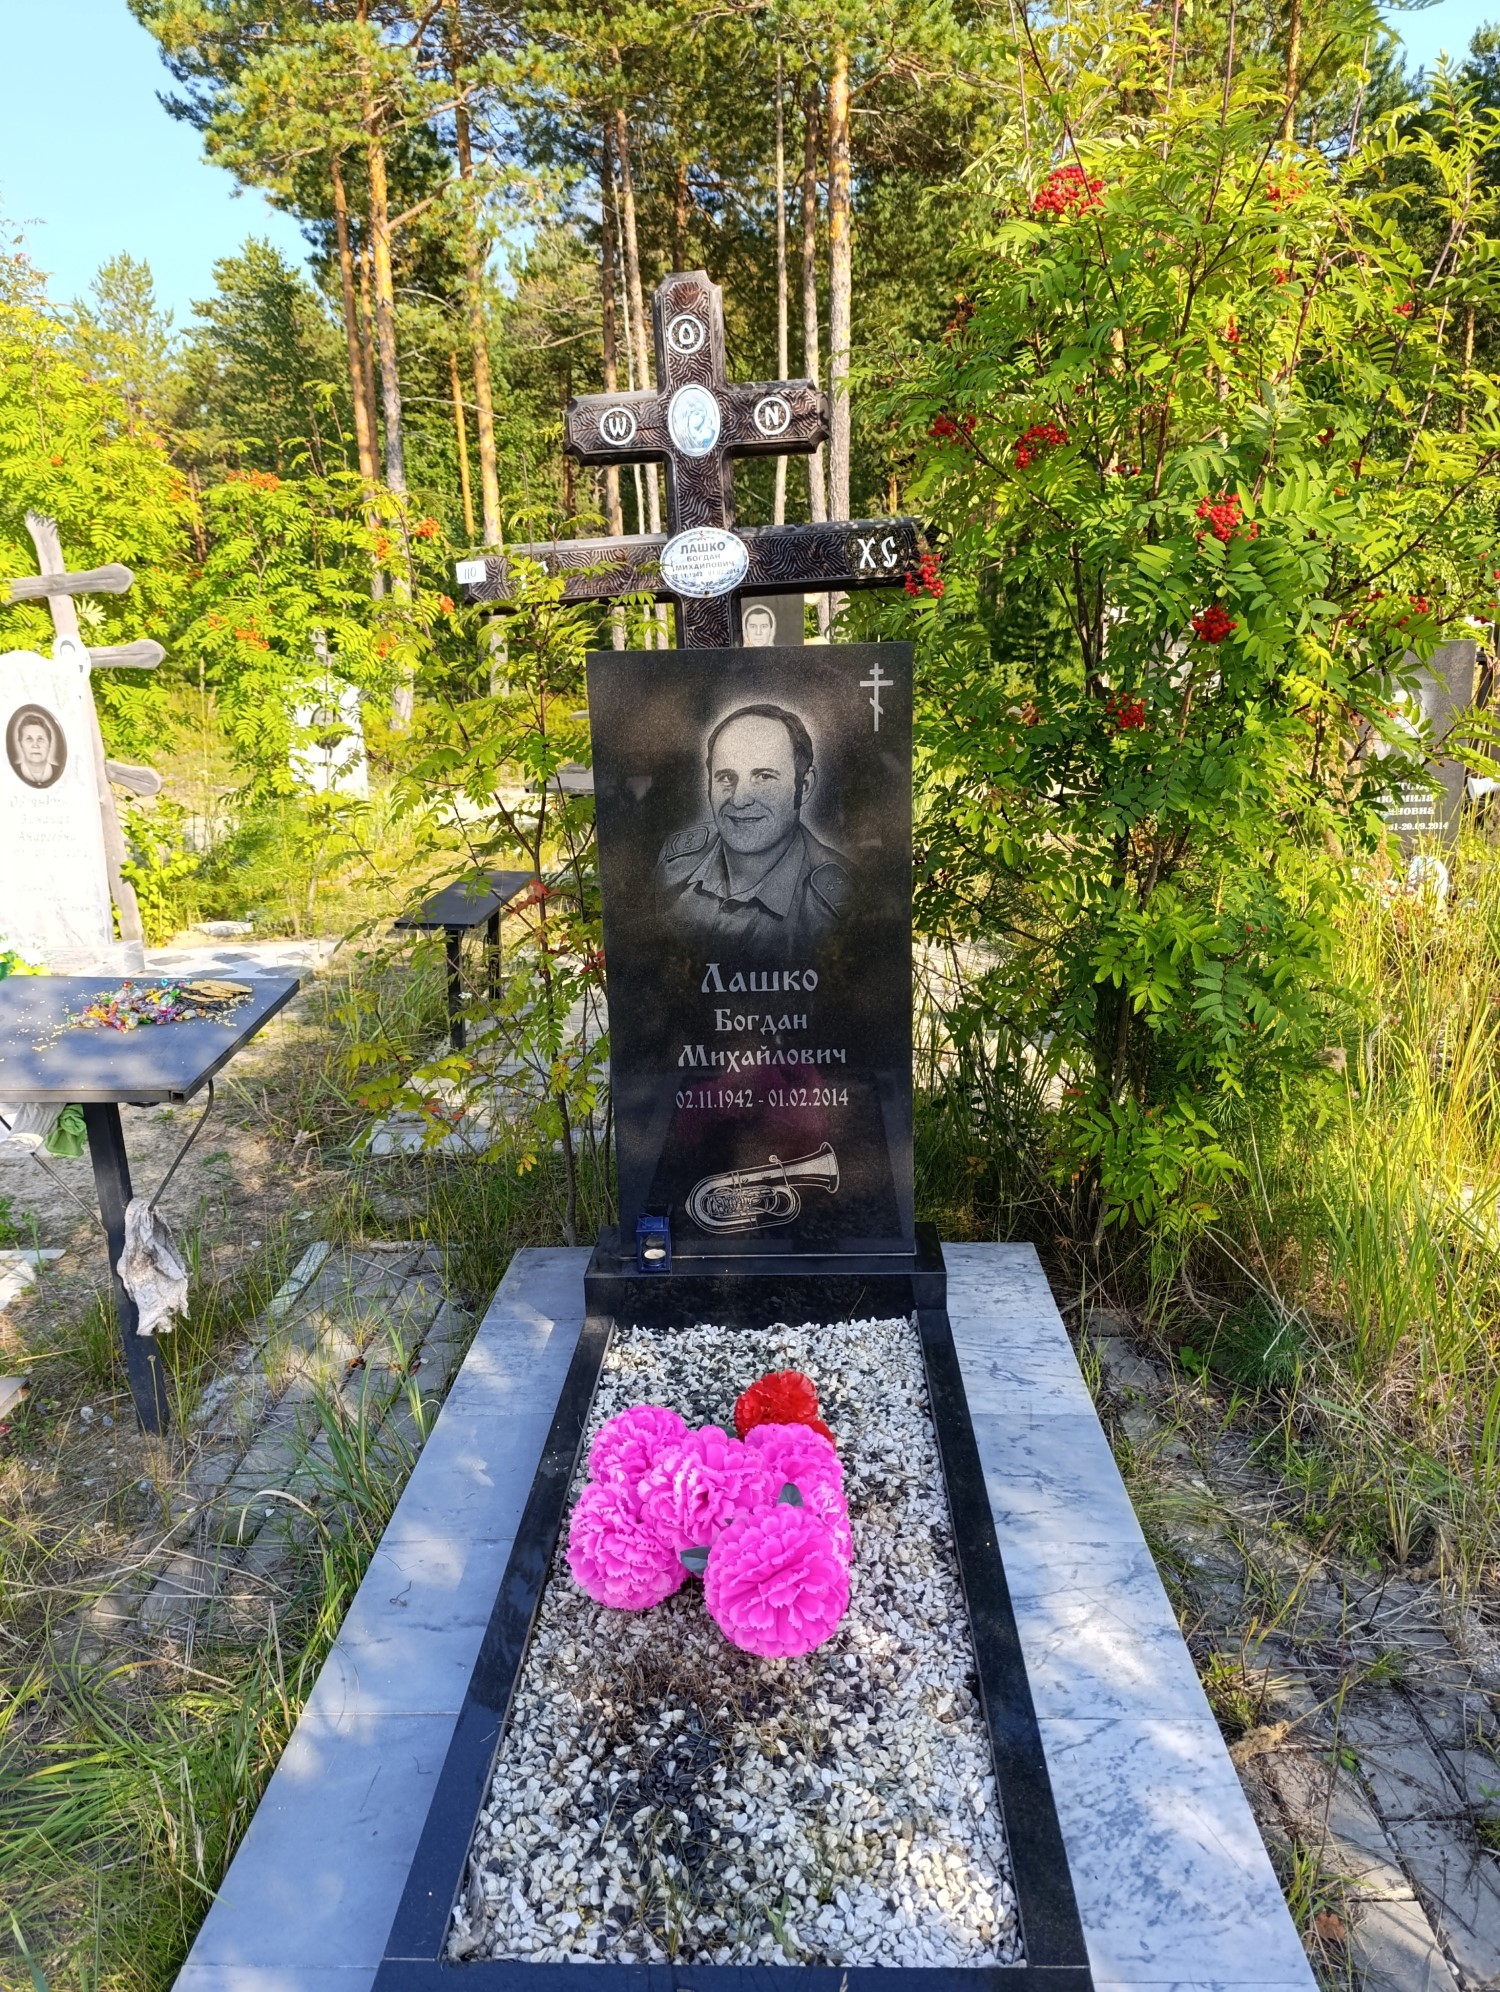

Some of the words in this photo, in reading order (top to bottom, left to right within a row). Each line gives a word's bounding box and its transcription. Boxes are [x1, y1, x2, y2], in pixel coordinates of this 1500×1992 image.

[680, 541, 726, 554] ЛАШКО
[686, 553, 721, 562] БОГДАН
[701, 963, 819, 993] Лашко
[714, 1008, 808, 1035] Богдан
[678, 1044, 847, 1073] Михайлович
[676, 1089, 753, 1109] 02.11.1942
[768, 1088, 849, 1108] 01.02.2014
